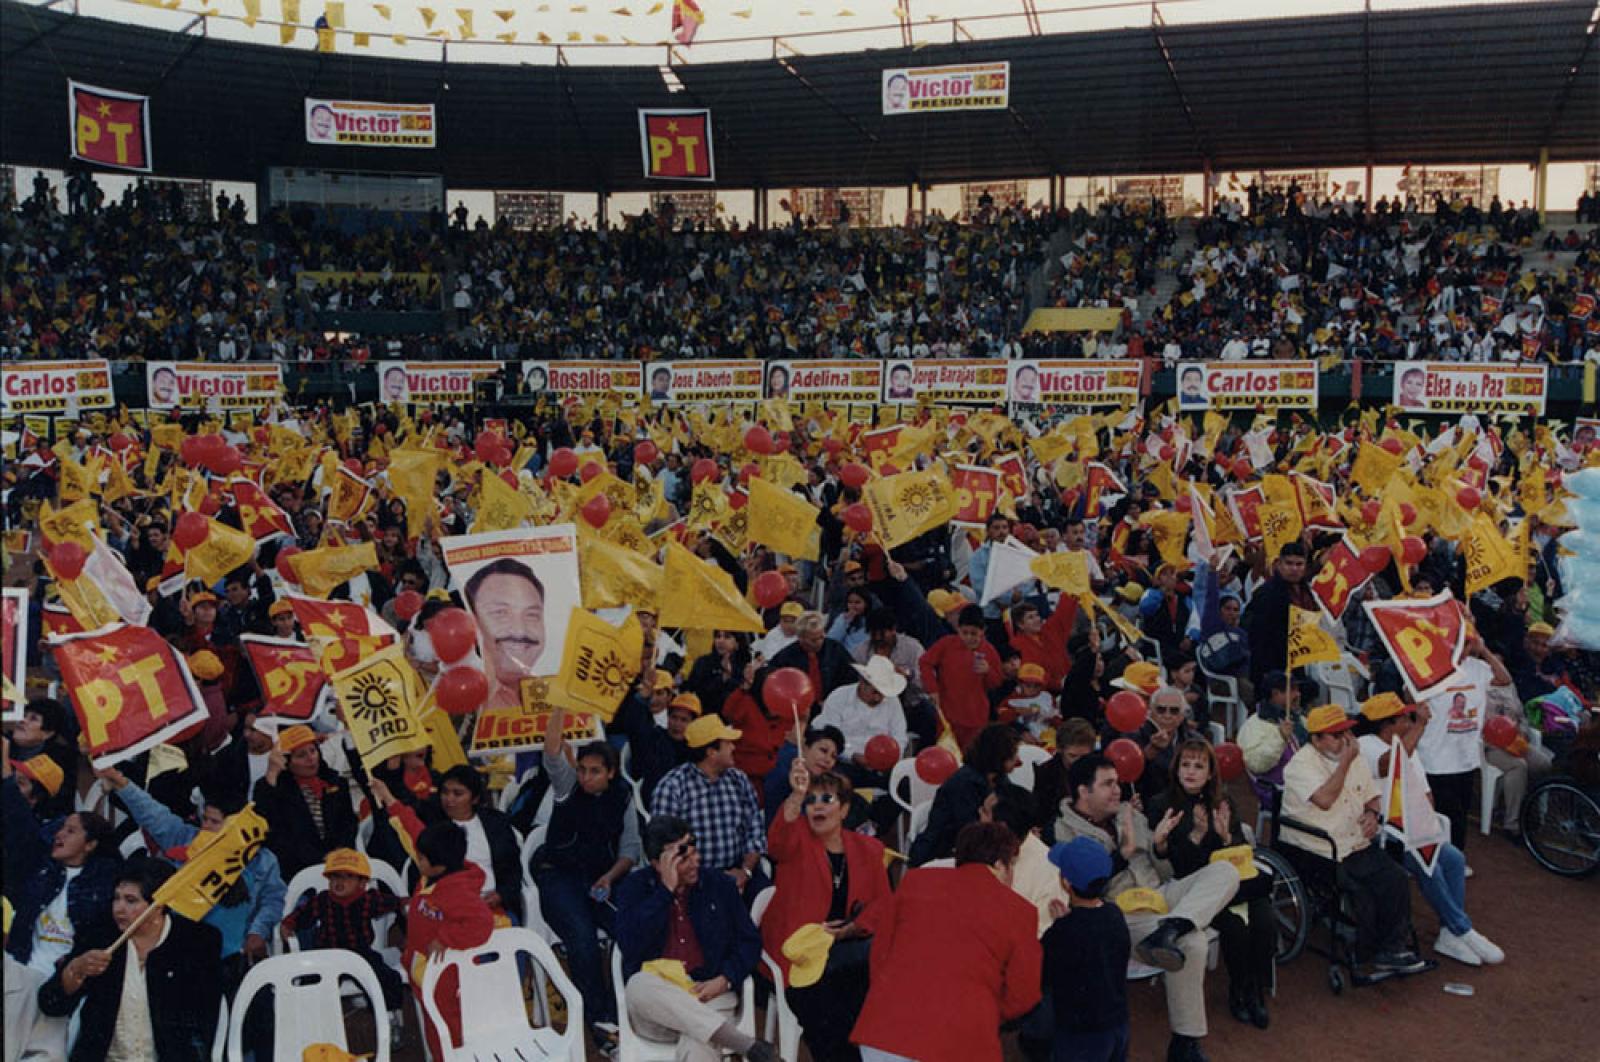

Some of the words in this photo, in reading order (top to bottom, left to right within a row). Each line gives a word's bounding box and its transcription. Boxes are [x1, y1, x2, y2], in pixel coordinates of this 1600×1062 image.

[911, 96, 1001, 108] PRESIDENTE
[77, 115, 133, 163] PT
[338, 132, 429, 144] PRESIDENTE
[649, 135, 699, 173] PT
[5, 373, 76, 396] Carlos
[791, 370, 849, 387] Adelina
[1207, 371, 1279, 392] Carlos
[1425, 373, 1451, 397] Elsa
[1455, 379, 1467, 397] de
[1469, 381, 1478, 397] la
[1481, 373, 1504, 398] Paz
[12, 396, 105, 409] DIPUTDO
[676, 391, 756, 400] DIPUTADO
[795, 391, 876, 401] DIPUTADO
[956, 487, 993, 518] PT
[240, 504, 281, 535] PT
[576, 645, 593, 681] PRD
[265, 661, 321, 704] PT
[75, 653, 169, 747] PT
[368, 717, 409, 745] PRD
[475, 729, 595, 750] PRESIDNTE
